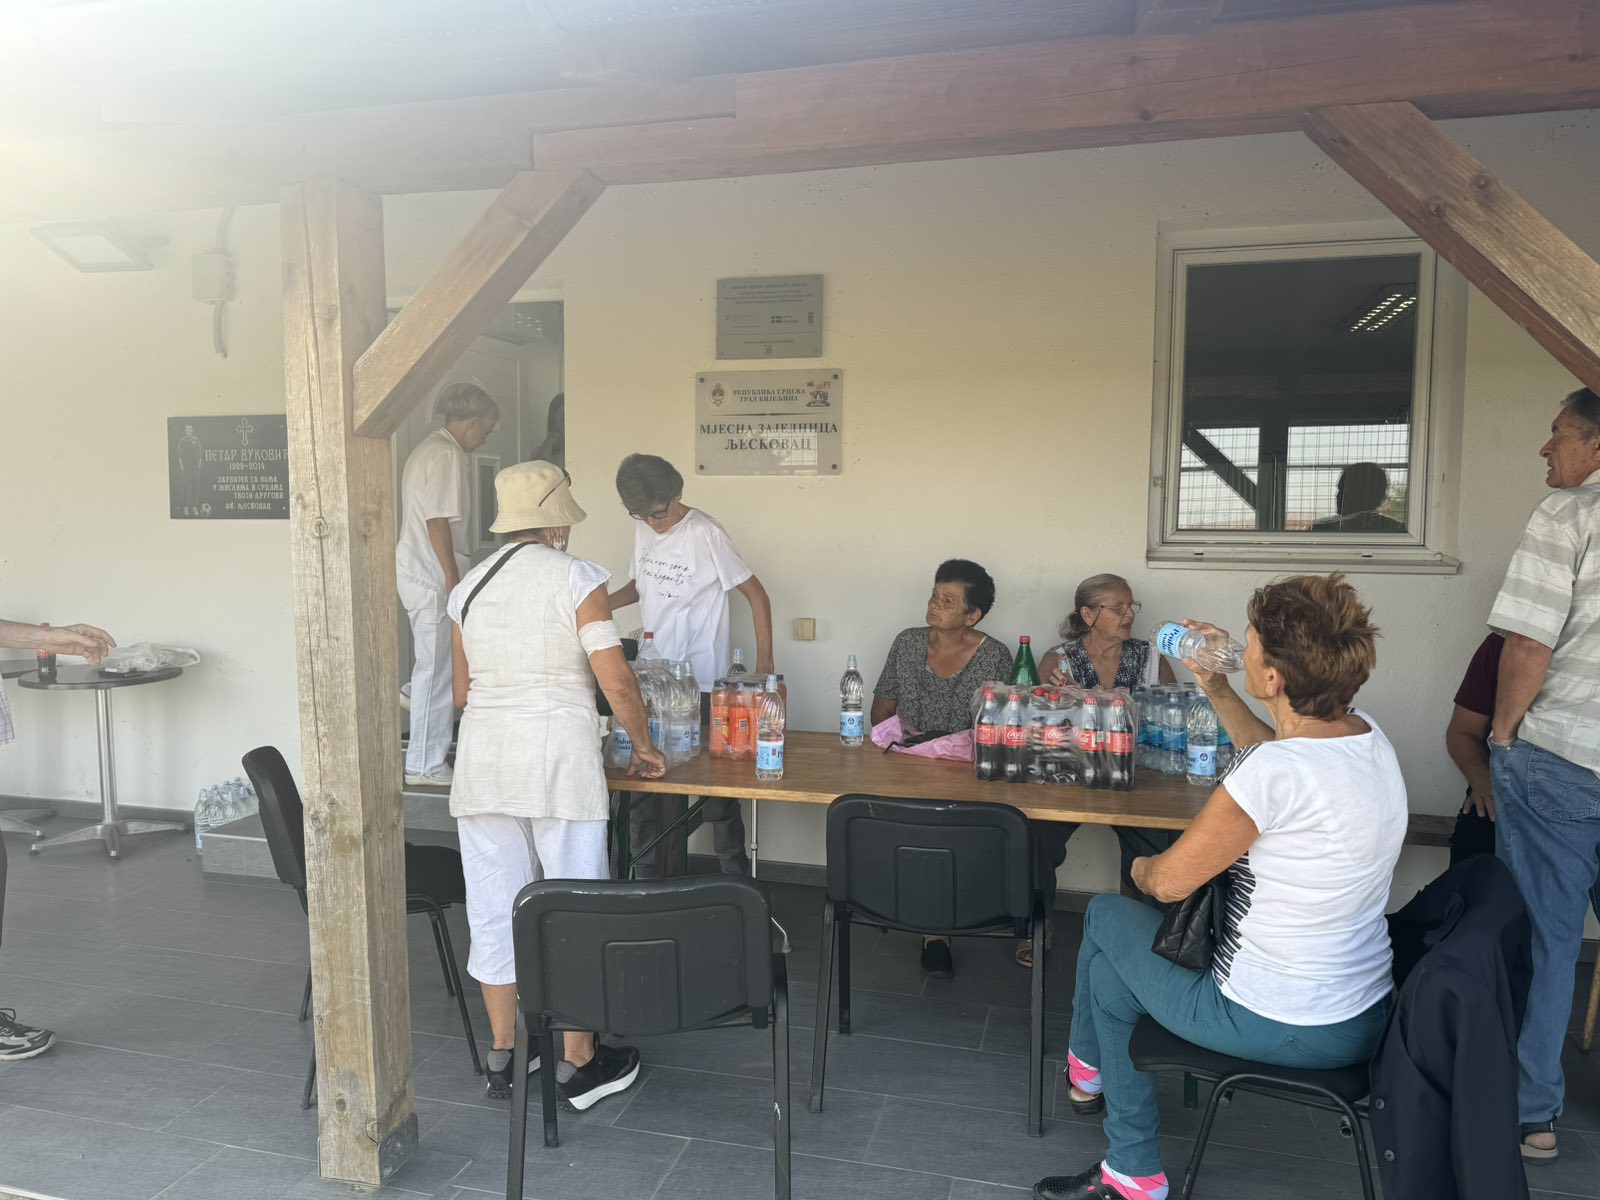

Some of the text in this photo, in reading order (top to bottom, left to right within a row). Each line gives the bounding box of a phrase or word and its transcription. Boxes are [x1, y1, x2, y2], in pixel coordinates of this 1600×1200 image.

[700, 422, 838, 434] МЈЕСНА ЗАЈЕДНИЦА
[724, 438, 812, 450] ЉЕСКОВАЦ
[205, 449, 237, 462] ПЕТАР
[250, 475, 258, 483] СА
